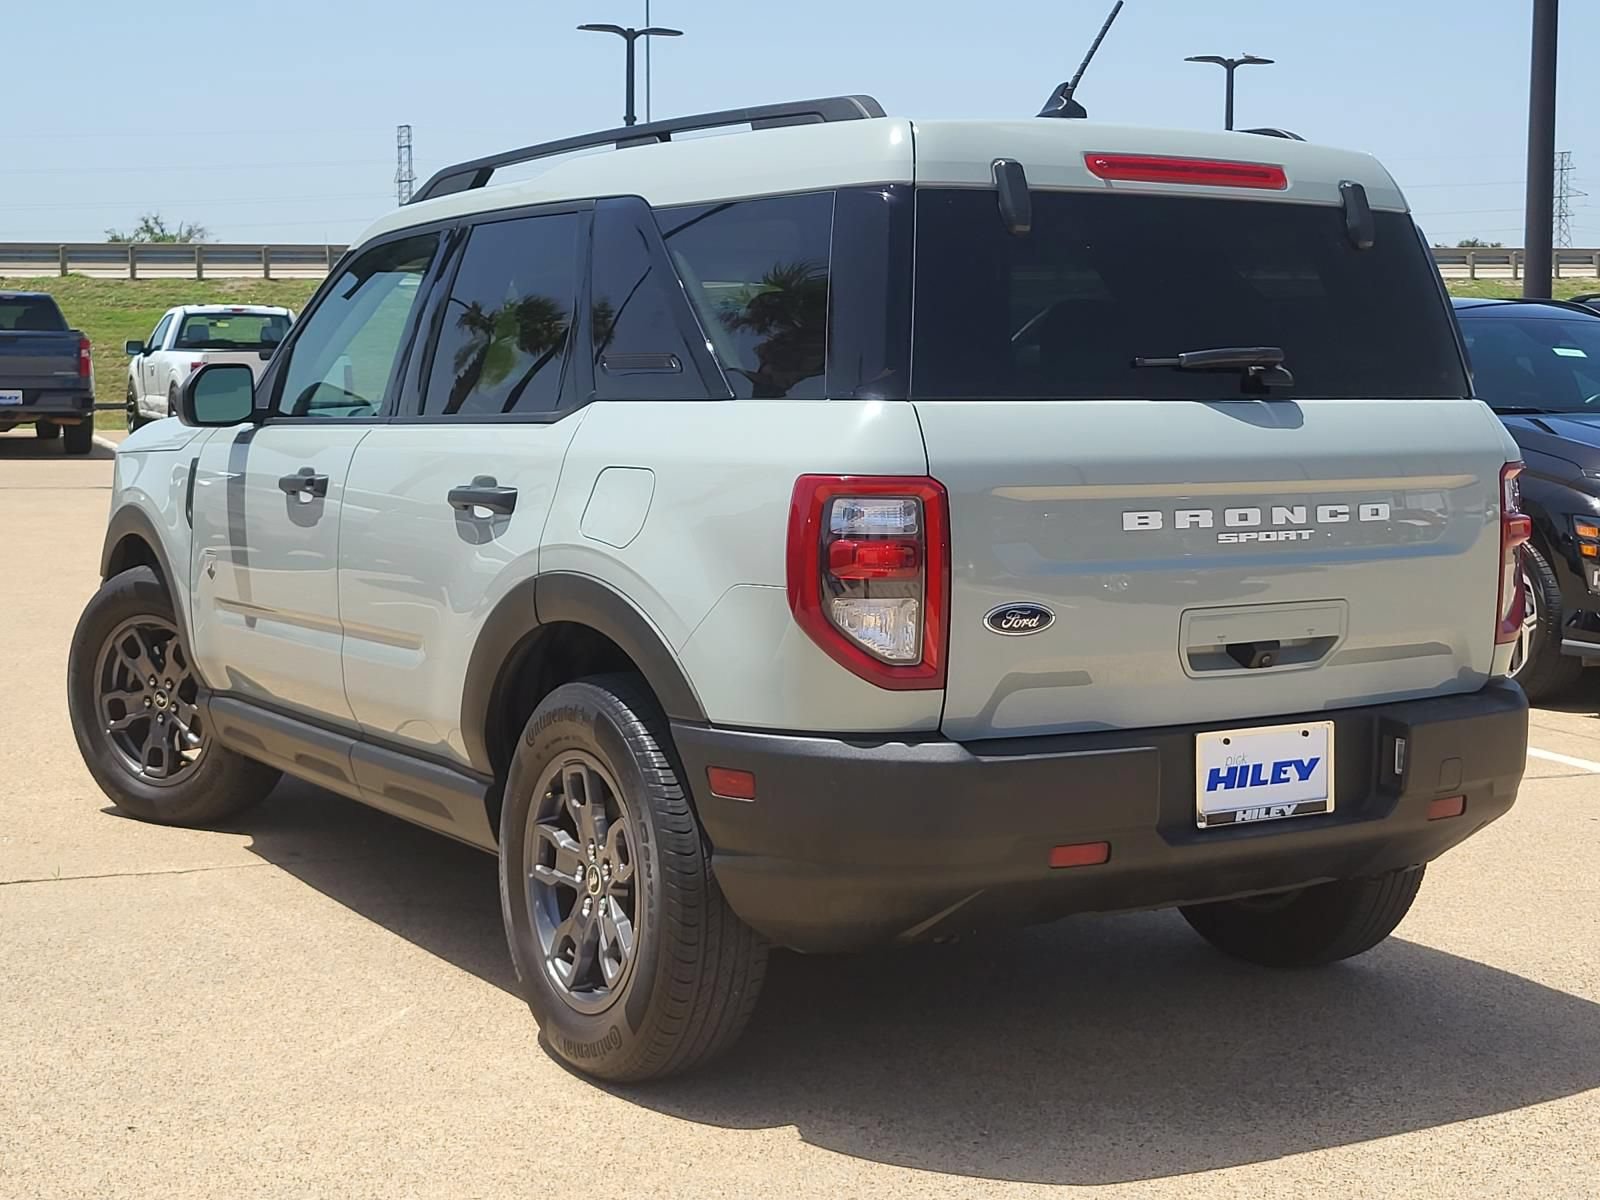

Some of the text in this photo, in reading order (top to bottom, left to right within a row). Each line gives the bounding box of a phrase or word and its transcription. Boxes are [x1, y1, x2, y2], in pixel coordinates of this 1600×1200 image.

[1122, 503, 1391, 530] BRONCO
[1217, 528, 1315, 543] SPORT
[1002, 609, 1040, 628] Ford
[525, 704, 580, 747] Continental
[1206, 756, 1321, 792] HILEY
[1235, 803, 1298, 823] HILEY
[563, 1025, 624, 1060] Continental
